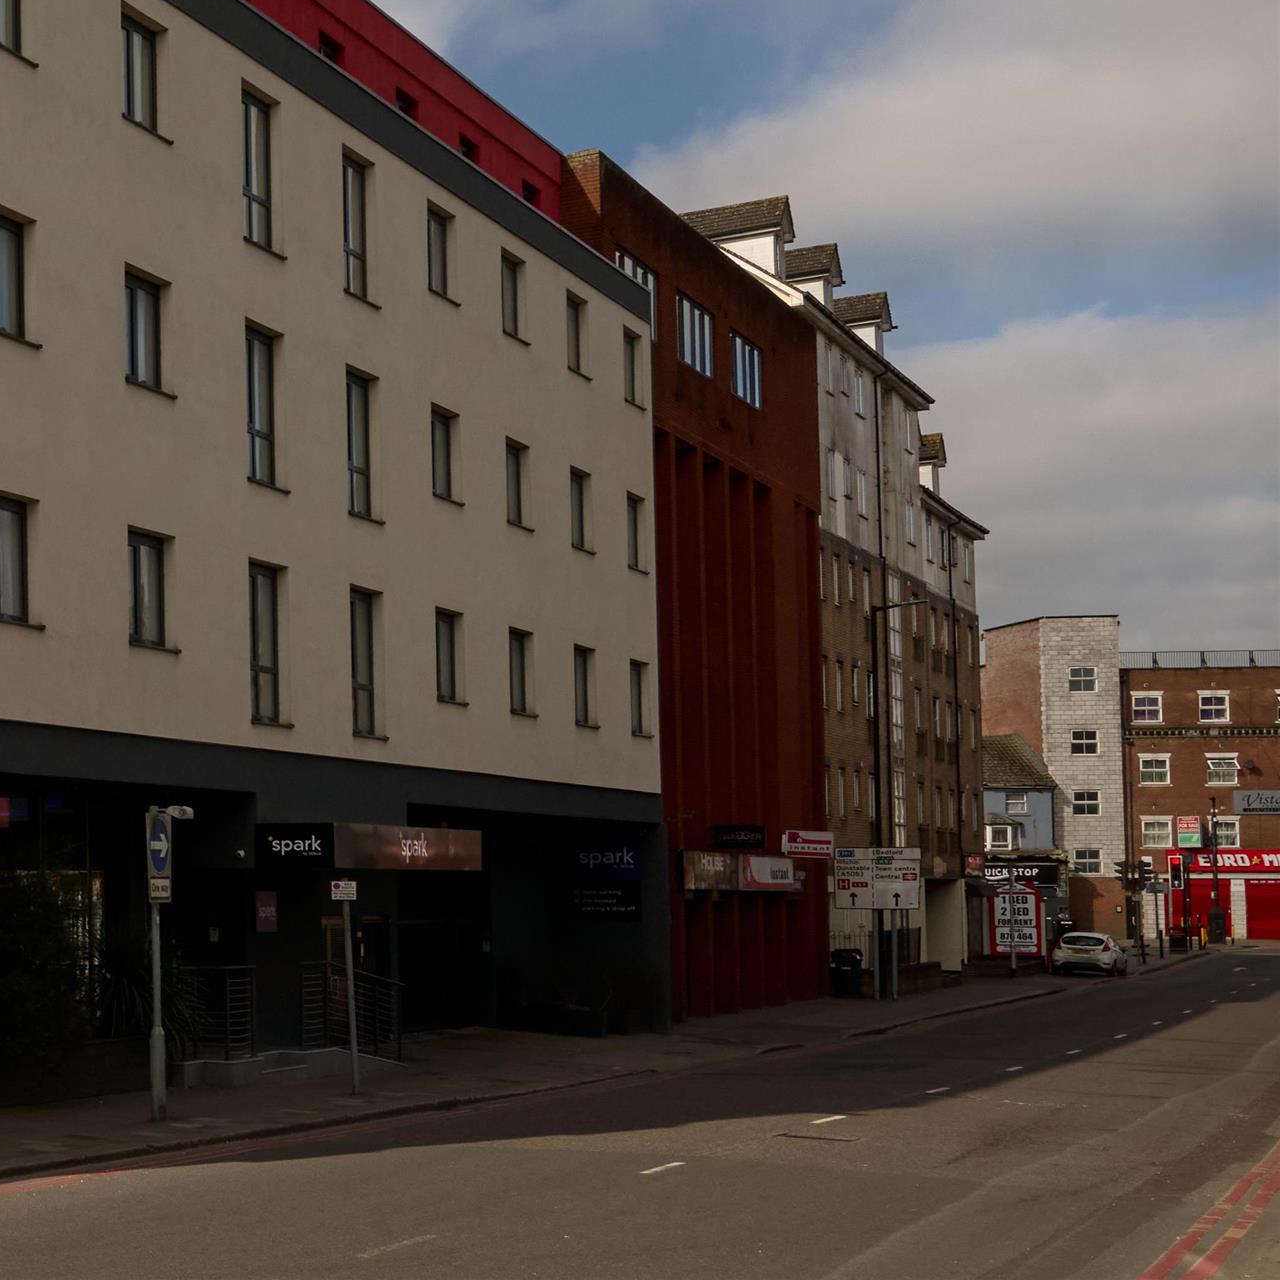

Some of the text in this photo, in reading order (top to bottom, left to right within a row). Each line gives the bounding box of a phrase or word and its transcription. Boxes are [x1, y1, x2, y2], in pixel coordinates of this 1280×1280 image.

[271, 834, 322, 856] spark
[401, 832, 428, 864] spark
[578, 847, 635, 869] spark
[1198, 854, 1280, 867] EURO M
[984, 868, 1039, 876] UICK STOP
[1000, 907, 1008, 916] 2
